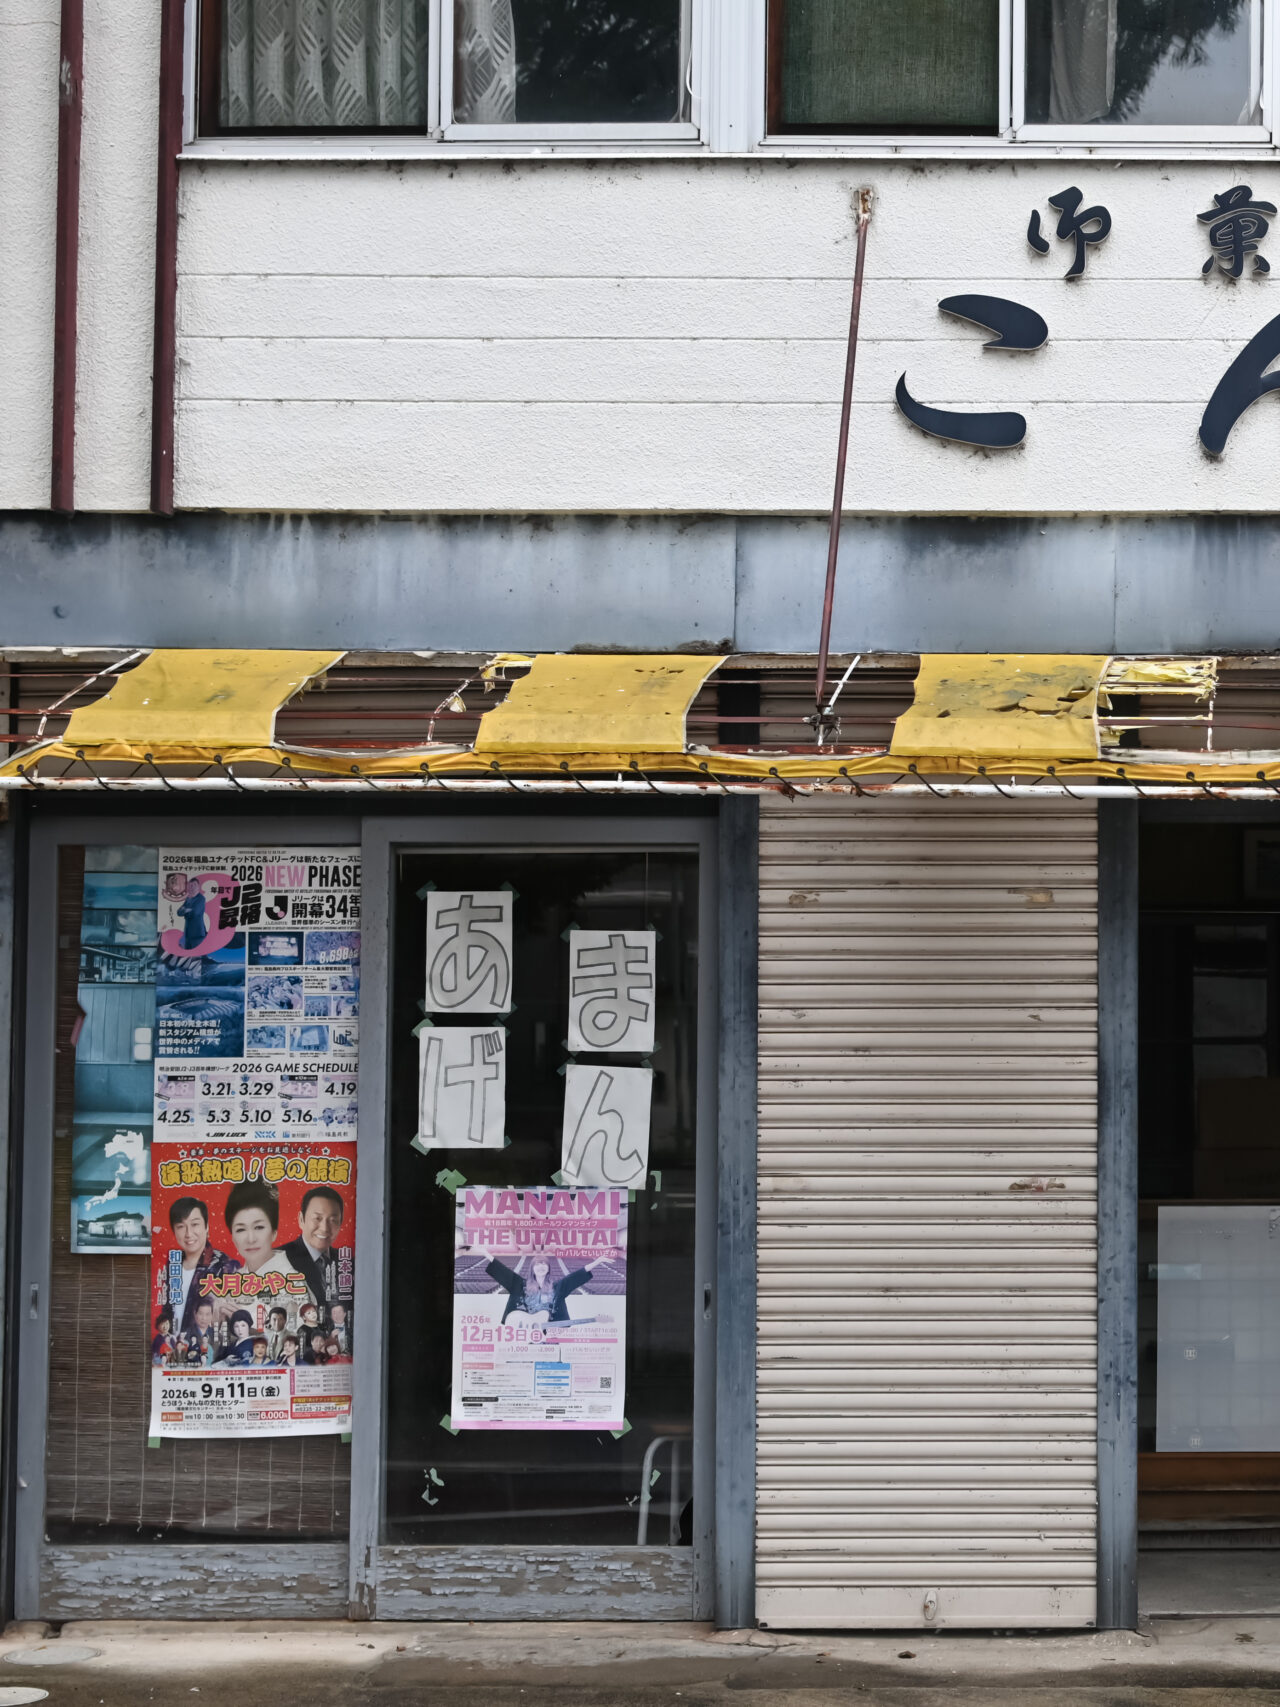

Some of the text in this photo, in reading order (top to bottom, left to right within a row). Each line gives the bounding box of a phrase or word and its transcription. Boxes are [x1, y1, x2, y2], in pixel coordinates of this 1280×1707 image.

[231, 865, 361, 887] 2026 NEW PHASE
[292, 895, 324, 903] Jリーグは
[231, 1063, 263, 1073] 2026
[264, 1063, 300, 1073] GAME
[302, 1063, 359, 1073] SCHEDULE
[201, 1082, 232, 1096] 3.21
[239, 1082, 274, 1096] 3.29
[325, 1082, 357, 1096] 4.19
[157, 1109, 191, 1123] 4.25
[206, 1109, 231, 1123] 5.3
[239, 1109, 272, 1123] 5.10
[281, 1109, 313, 1123] 5.16
[464, 1190, 621, 1216] MANAMI
[464, 1229, 617, 1246] THE UTAUTAI
[169, 1250, 183, 1305] 和田青児
[338, 1246, 353, 1301] 山本譲二
[199, 1271, 308, 1298] 大月みやこ
[461, 1315, 491, 1324] 2026年
[160, 1389, 198, 1399] 2026年
